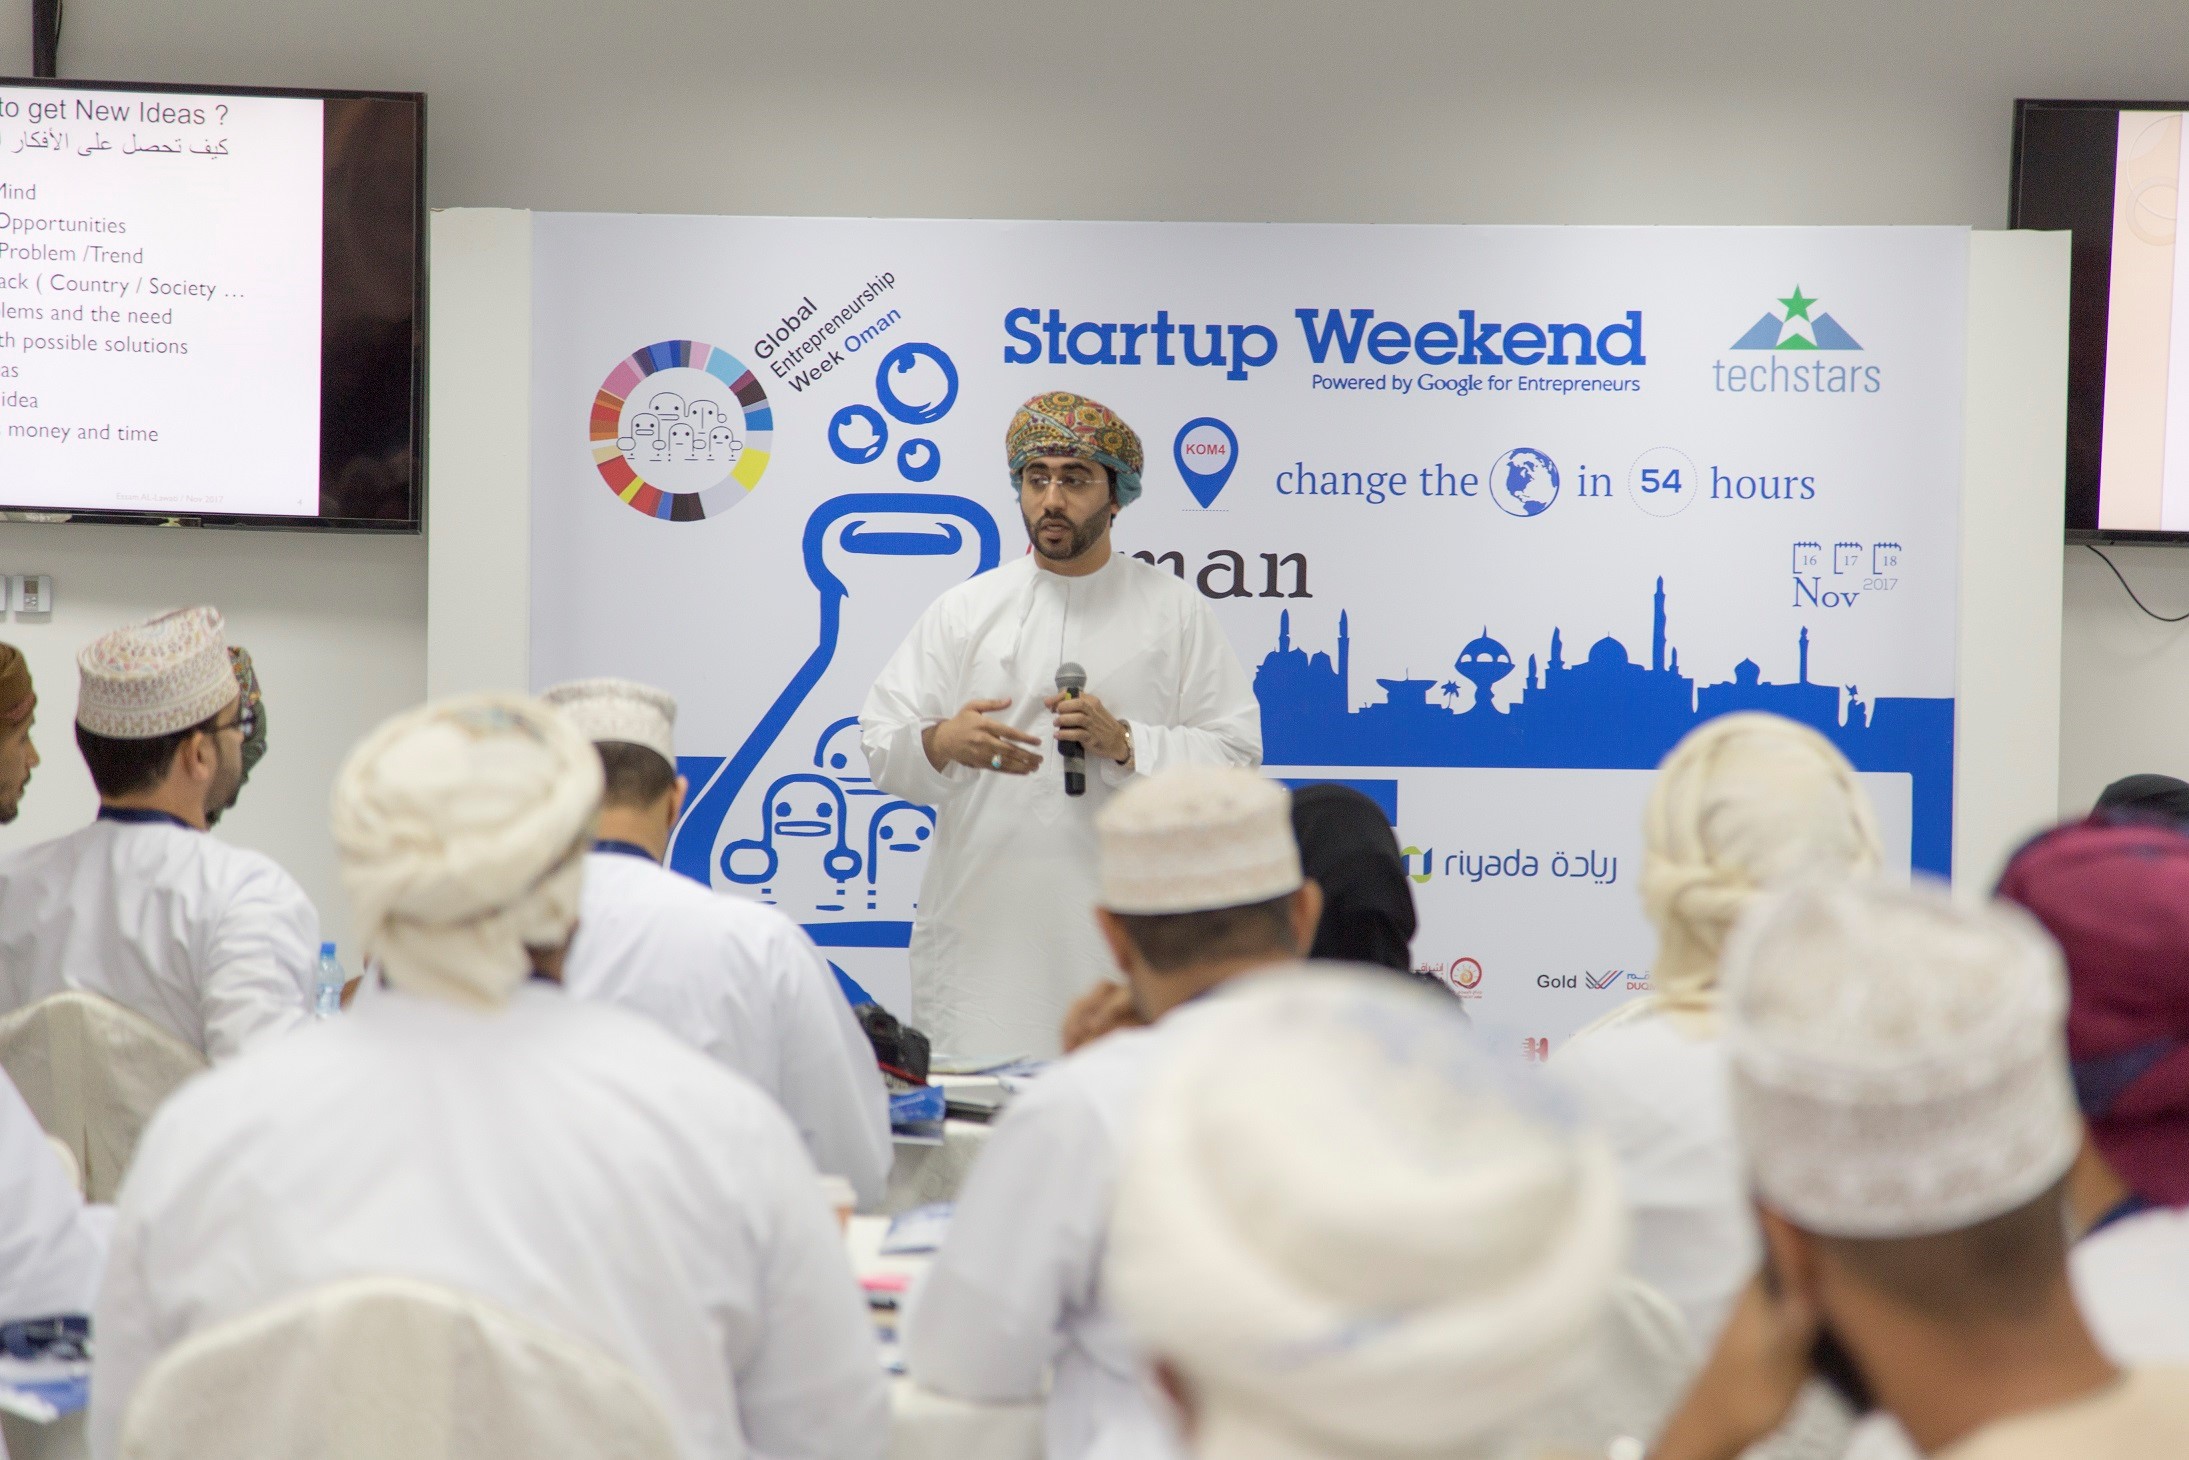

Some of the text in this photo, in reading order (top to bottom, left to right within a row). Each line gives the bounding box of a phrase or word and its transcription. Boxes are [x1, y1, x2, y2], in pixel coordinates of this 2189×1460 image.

[28, 100, 67, 124] get
[76, 99, 131, 122] New
[140, 102, 206, 125] Ideas
[215, 104, 229, 125] ?
[11, 127, 229, 160] كيف تحصل على الأفكار
[0, 212, 127, 235] Opportunities
[0, 242, 76, 262] Problem
[50, 275, 129, 298] Country
[149, 278, 217, 301] Society
[50, 305, 83, 321] and
[91, 305, 121, 323] the
[128, 308, 172, 325] need
[770, 271, 894, 378] Entrepreneurship
[754, 296, 818, 361] Global
[23, 334, 98, 353] possible
[105, 336, 188, 355] solutions
[788, 309, 901, 393] Week Oman
[1004, 307, 1647, 381] Startup Weekend
[1312, 373, 1641, 396] Powered by Google for Entrepreneurs
[1712, 355, 1881, 393] techstars
[2, 391, 38, 408] idea
[8, 424, 159, 443] money and time
[1185, 443, 1226, 456] KOM4
[1276, 461, 1816, 504] change the in 54 hours
[1803, 555, 1898, 567] 16 17 18
[1792, 576, 1899, 608] Nov 2017
[1445, 849, 1539, 883] riyada
[1551, 850, 1618, 884] ريادة
[1537, 974, 1577, 989] Gold
[1626, 982, 1656, 991] DUQ
